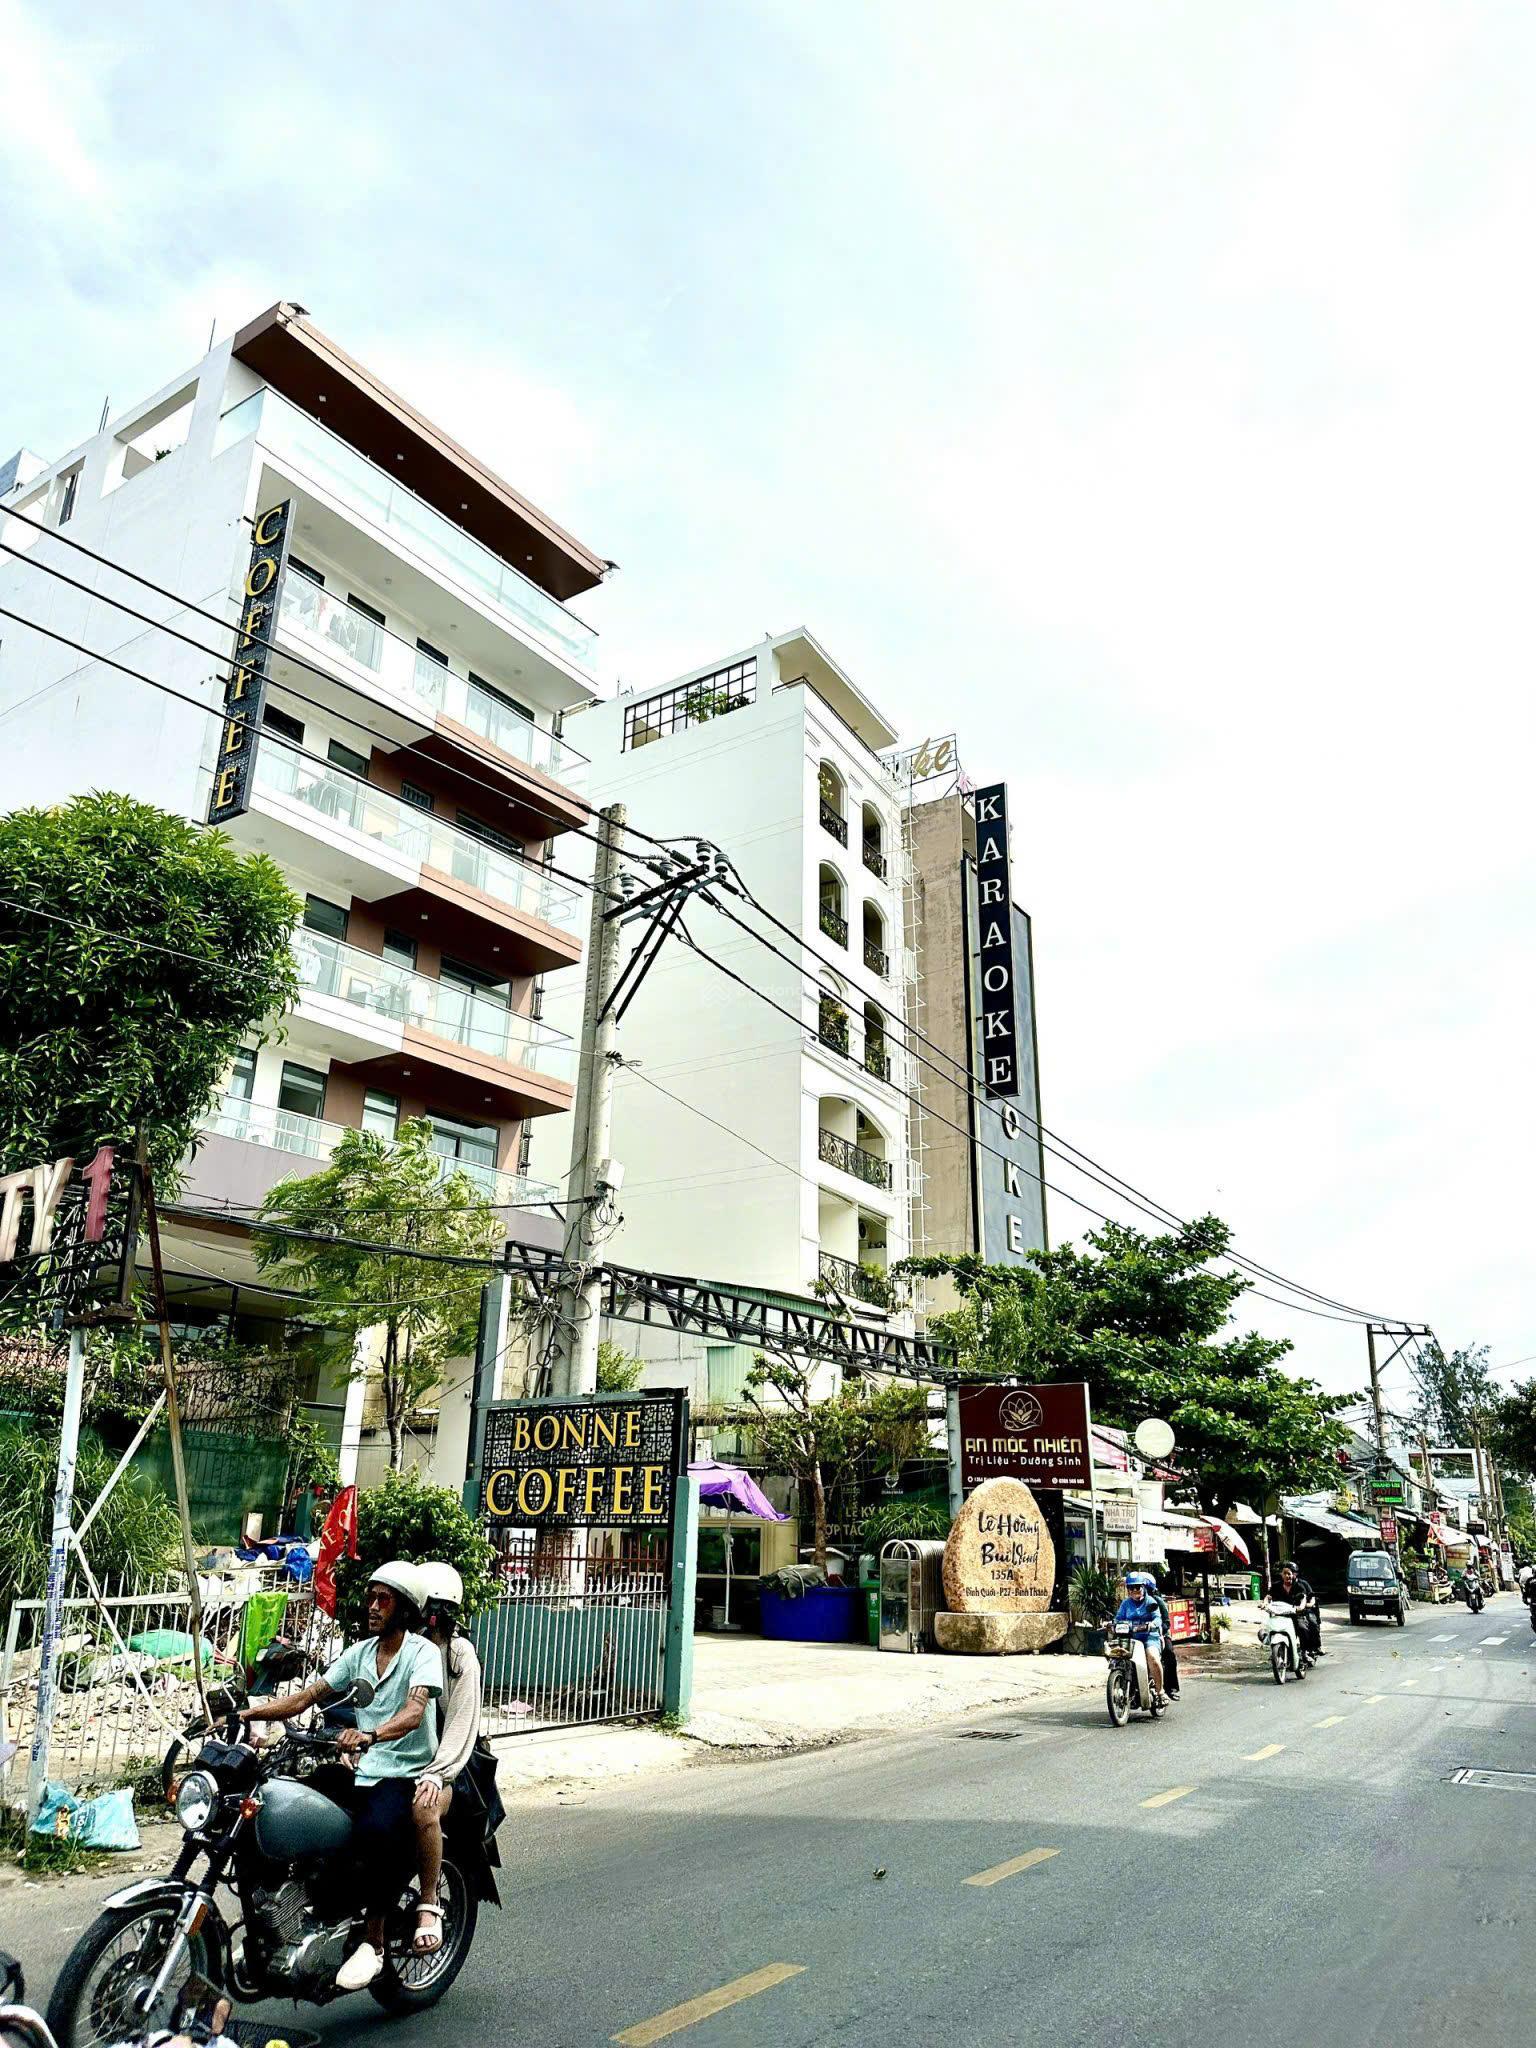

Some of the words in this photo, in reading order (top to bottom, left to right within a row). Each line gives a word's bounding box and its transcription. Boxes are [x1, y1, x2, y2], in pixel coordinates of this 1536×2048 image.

[215, 507, 283, 811] COFFEE
[977, 795, 1012, 1086] KARAOKE
[513, 1410, 641, 1452] BONNE
[992, 1436, 1028, 1455] MỘC
[969, 1456, 984, 1467] Trị
[987, 1456, 1009, 1467] Liệu
[1020, 1456, 1054, 1467] Dưỡng
[1057, 1457, 1081, 1466] Sinh
[486, 1465, 664, 1516] COFFEE
[991, 1569, 1014, 1580] 135A
